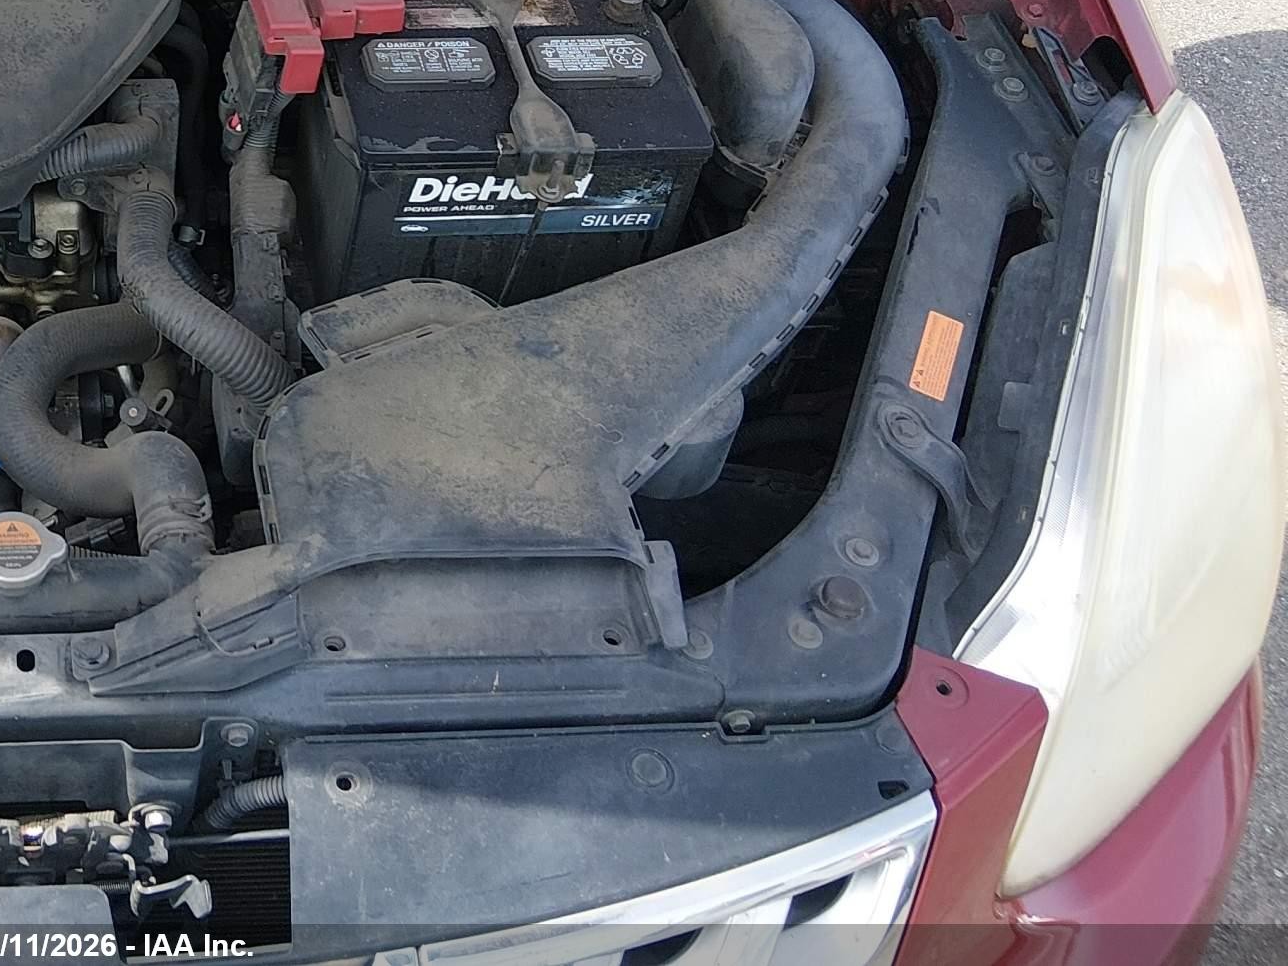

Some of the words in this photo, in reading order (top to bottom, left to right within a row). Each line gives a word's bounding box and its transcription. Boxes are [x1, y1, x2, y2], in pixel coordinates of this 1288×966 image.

[408, 173, 594, 203] DieHd
[450, 204, 495, 212] AHEAD
[580, 213, 651, 228] SILVER
